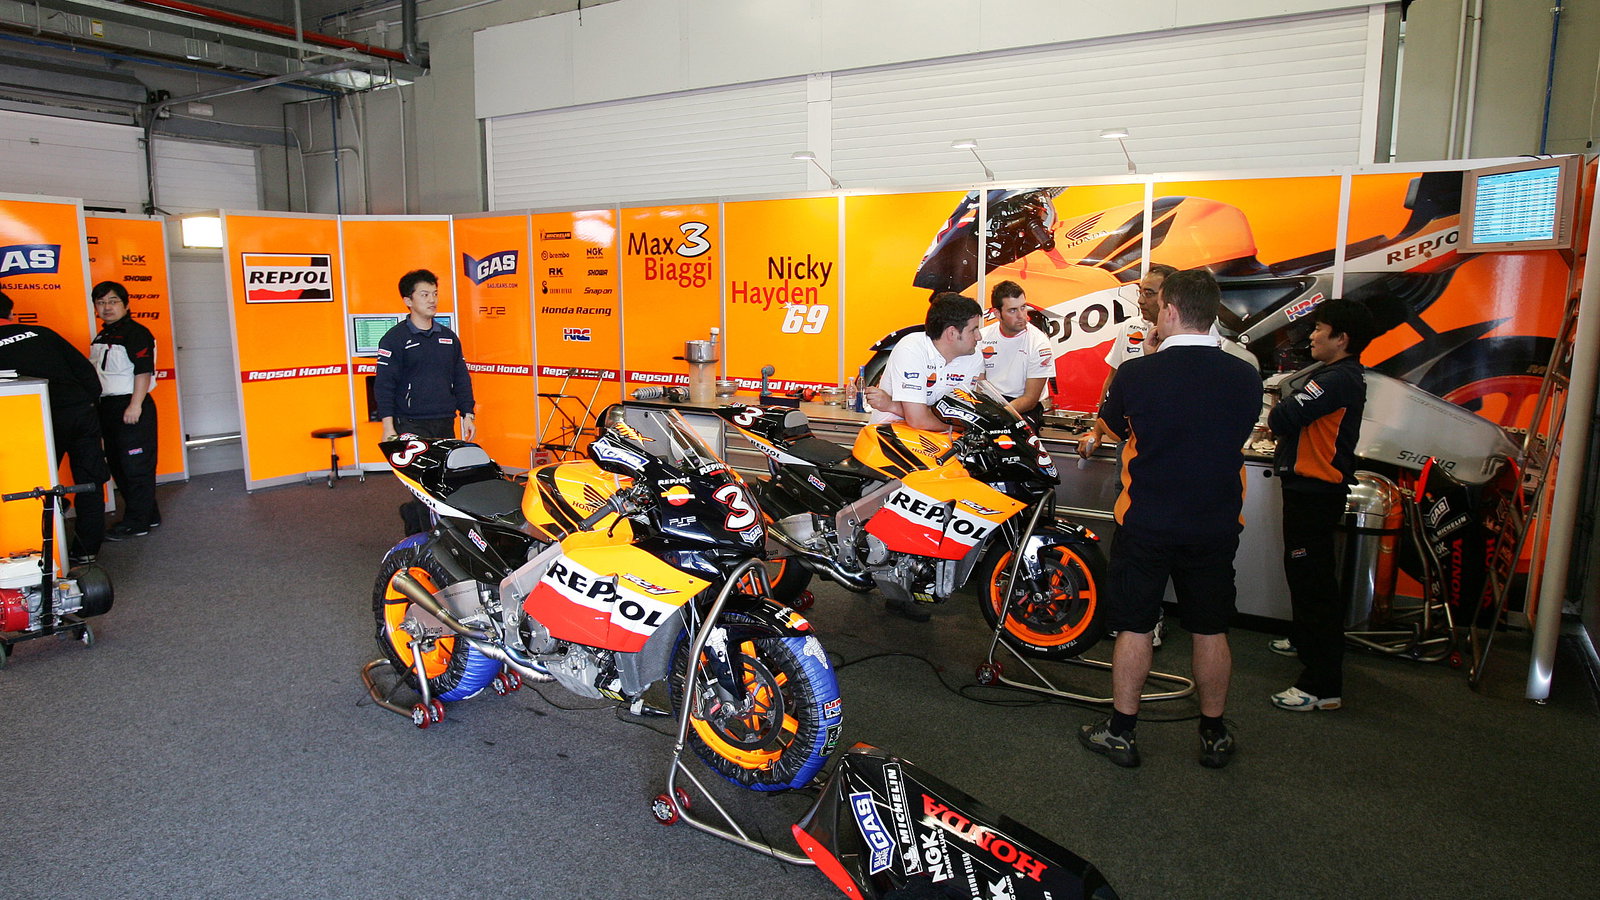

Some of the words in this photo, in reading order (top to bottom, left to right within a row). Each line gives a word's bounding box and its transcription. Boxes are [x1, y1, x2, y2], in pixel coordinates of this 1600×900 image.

[628, 232, 674, 255] Max
[676, 222, 711, 257] 3
[1067, 230, 1108, 248] HONDA
[1387, 230, 1459, 266] REPSO
[0, 249, 55, 273] AS
[121, 255, 146, 263] NGK
[477, 254, 516, 280] GAS
[249, 271, 329, 284] REPSOL
[644, 256, 712, 288] Biaggi
[768, 254, 833, 287] Nicky
[583, 287, 613, 296] Snap-on
[731, 279, 818, 311] Hayden
[130, 312, 160, 320] cing
[479, 306, 506, 315] PS2
[541, 306, 575, 315] Honda
[576, 307, 612, 317] Racing
[1284, 292, 1325, 322] HRC
[781, 304, 830, 334] 69
[1046, 300, 1132, 344] SOL
[0, 331, 39, 347] NDA
[563, 328, 592, 342] HRC
[249, 368, 296, 381] Repsol
[300, 366, 342, 376] Honda
[466, 363, 495, 373] Repsol
[497, 364, 529, 374] Honda
[543, 366, 579, 377] Reps
[631, 372, 673, 383] Repsol
[946, 373, 966, 382] HRC
[784, 382, 827, 392] Hond
[732, 406, 765, 428] 3
[389, 440, 429, 468] 3
[750, 439, 781, 459] REPSOL
[699, 462, 727, 475] REPSO
[657, 477, 691, 485] REPSOL
[807, 474, 826, 492] HRC
[572, 500, 599, 513] HON
[712, 483, 758, 532] 3
[890, 492, 988, 540] REPSOL
[1430, 501, 1446, 525] GAS
[669, 516, 697, 526] PS2
[1436, 516, 1467, 536] MICHELIN
[468, 529, 488, 552] HRC
[546, 560, 662, 627] REPSOL
[887, 769, 911, 844] MICHELIN
[856, 798, 890, 850] GAS
[921, 793, 1049, 882] HONDA
[936, 828, 948, 853] PLUGS
[920, 830, 948, 883] NGK
[943, 853, 955, 879] SPARK
[962, 853, 974, 874] DENKO
[967, 873, 980, 896] SHOWA
[988, 876, 1011, 900] K
[1005, 875, 1016, 894] CHAIN
